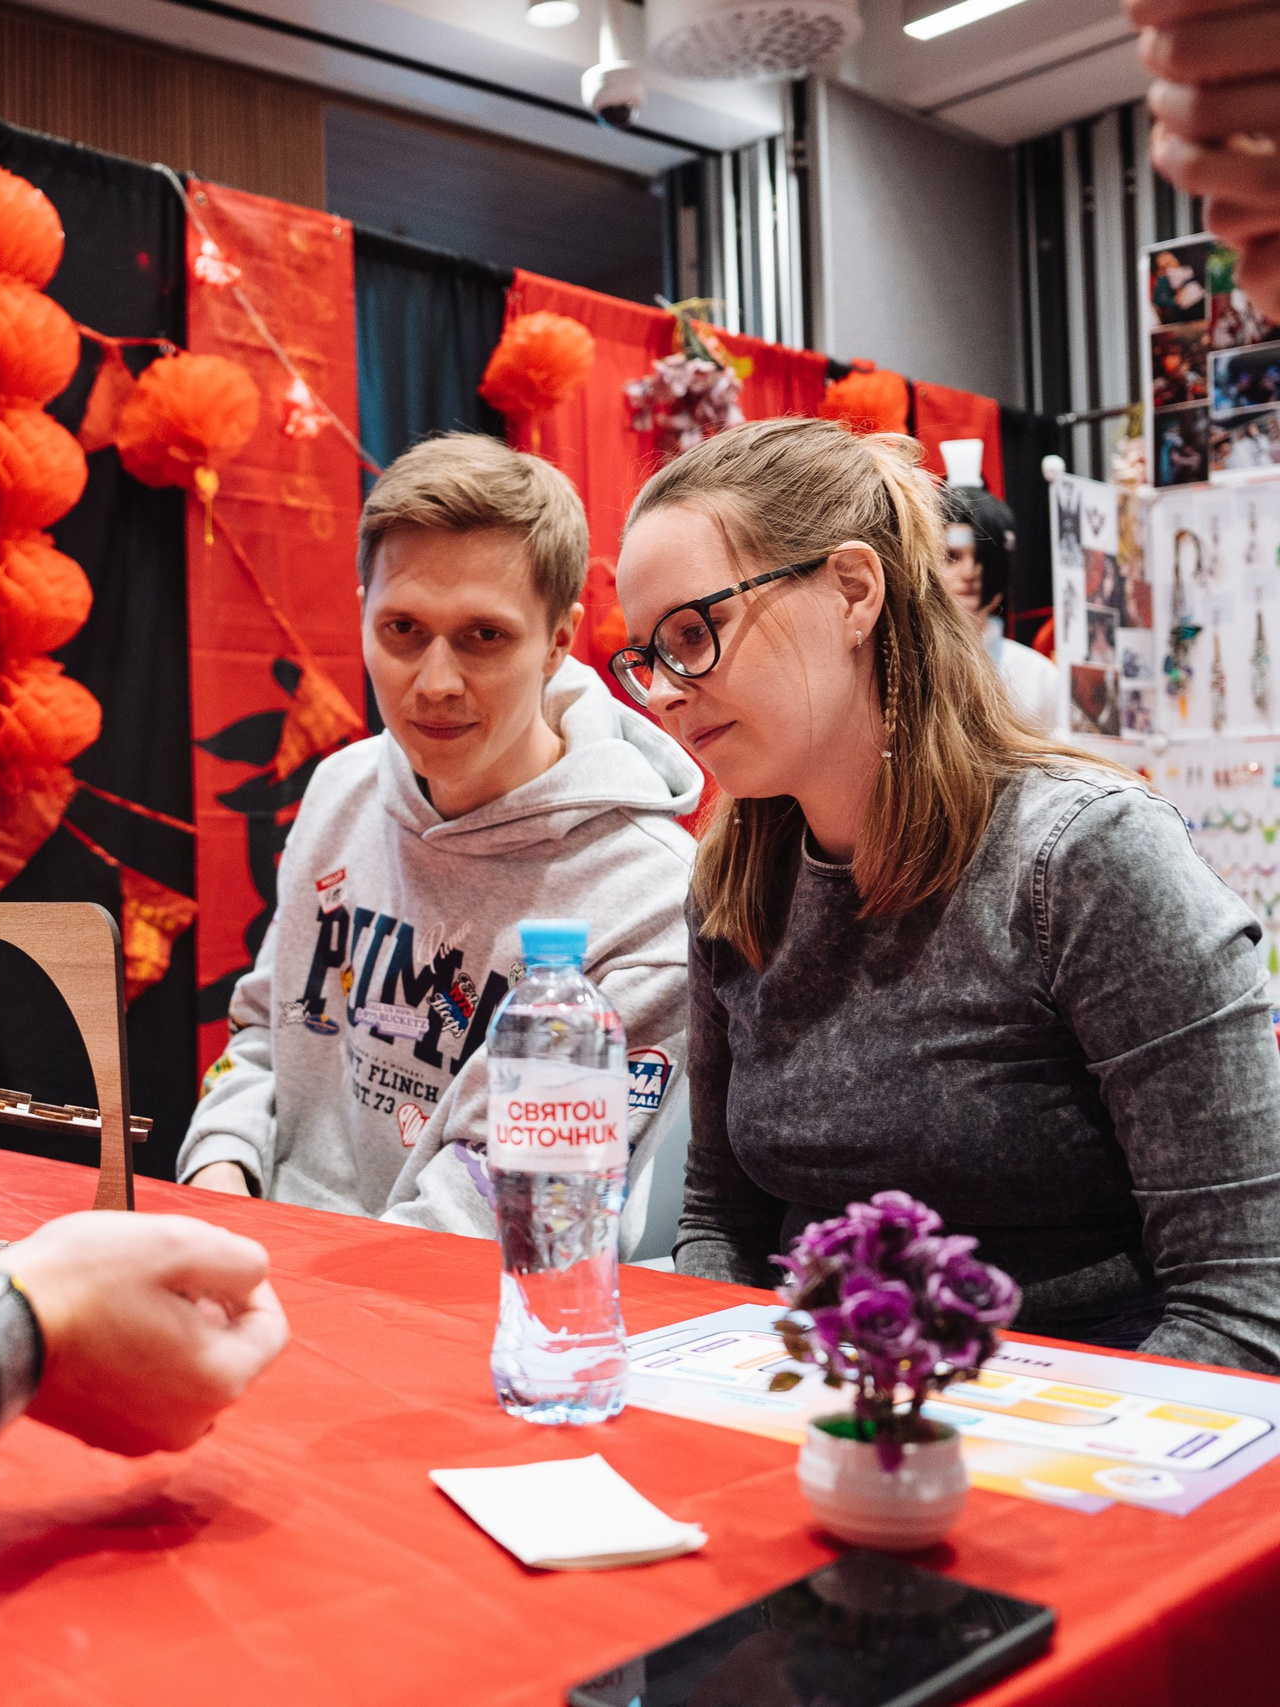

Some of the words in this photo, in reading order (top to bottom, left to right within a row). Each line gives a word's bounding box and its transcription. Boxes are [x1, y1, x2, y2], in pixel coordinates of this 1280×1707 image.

[426, 992, 465, 1038] Hoops
[368, 1063, 440, 1103] FLINCH
[373, 1092, 396, 1114] 73
[496, 1121, 618, 1147] ИСТОЧНИК
